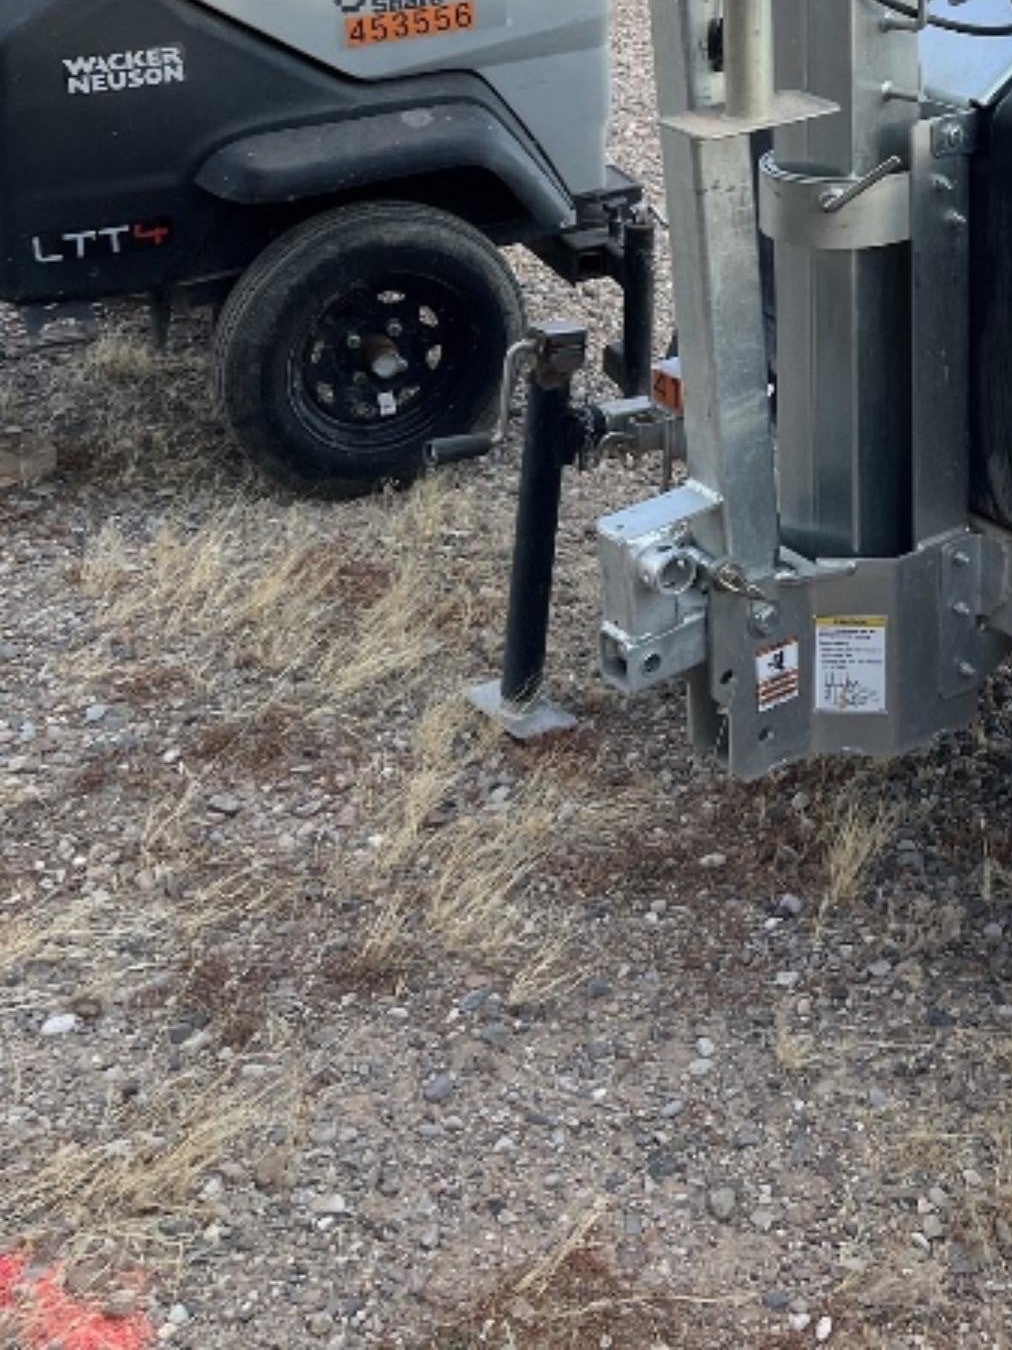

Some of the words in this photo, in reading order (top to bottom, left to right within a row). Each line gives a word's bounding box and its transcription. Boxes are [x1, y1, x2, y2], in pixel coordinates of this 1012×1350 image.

[349, 1, 473, 42] 453556
[61, 46, 184, 77] WACKER
[67, 64, 185, 94] NEUSON
[31, 223, 169, 263] LTT4
